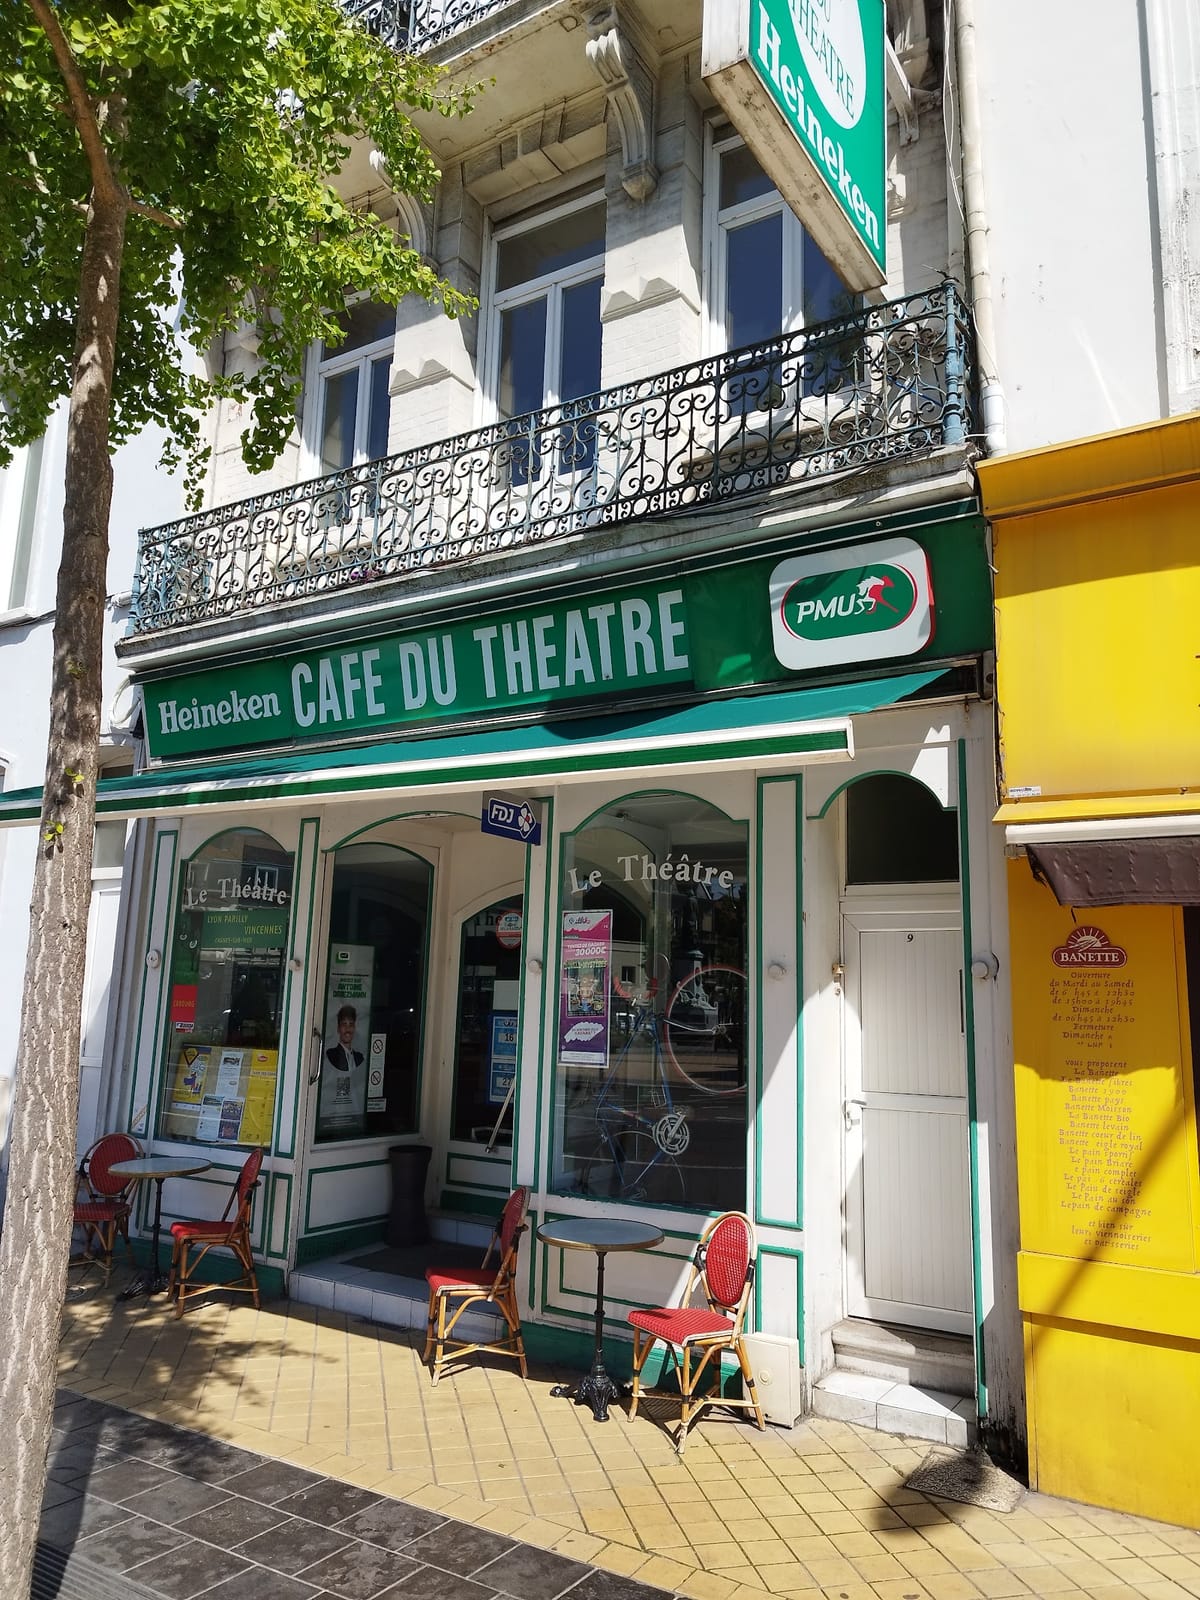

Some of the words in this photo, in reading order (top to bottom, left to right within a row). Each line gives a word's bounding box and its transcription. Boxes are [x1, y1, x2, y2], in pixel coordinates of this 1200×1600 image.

[793, 0, 854, 119] HEATRE
[757, 1, 880, 250] Heineken
[796, 593, 856, 623] PMU
[291, 648, 386, 727] CAFE
[399, 634, 457, 710] DU
[473, 589, 689, 698] THEATRE
[158, 690, 281, 734] Heineken
[491, 804, 514, 823] FDJ
[568, 867, 602, 894] Le
[617, 853, 734, 889] Théâtre
[186, 887, 208, 907] Le
[217, 876, 287, 905] Théâtre
[244, 924, 283, 935] VINCENNES
[906, 933, 914, 942] 9
[1060, 952, 1120, 962] BANETTE
[1063, 979, 1088, 987] Mardi
[1104, 979, 1134, 988] Samedi
[1072, 1006, 1113, 1014] Dimanche
[1106, 1014, 1135, 1023] 12h30
[1074, 1023, 1114, 1031] Fermeture
[1062, 1031, 1104, 1040] Dimanche
[1087, 1060, 1127, 1070] proposent
[1088, 1068, 1119, 1076] Banette
[1069, 1085, 1099, 1094] Banette
[1071, 1095, 1101, 1103] Banette
[1065, 1103, 1095, 1111] Banette
[1083, 1112, 1113, 1120] Banette
[1117, 1114, 1130, 1122] Bio
[1070, 1121, 1100, 1129] Banette
[1103, 1121, 1129, 1131] levain
[1059, 1129, 1089, 1137] Banette
[1116, 1132, 1126, 1140] de
[1059, 1138, 1089, 1146] Banette
[1096, 1140, 1117, 1151] eigle
[1120, 1141, 1143, 1152] royal
[1082, 1149, 1101, 1158] pain
[1084, 1158, 1103, 1167] pain
[1082, 1167, 1100, 1176] pain
[1104, 1168, 1137, 1180] complet
[1115, 1187, 1141, 1199] seigle
[1094, 1202, 1103, 1211] de
[1107, 1206, 1151, 1218] campagne
[1096, 1230, 1151, 1242] viennoiseries
